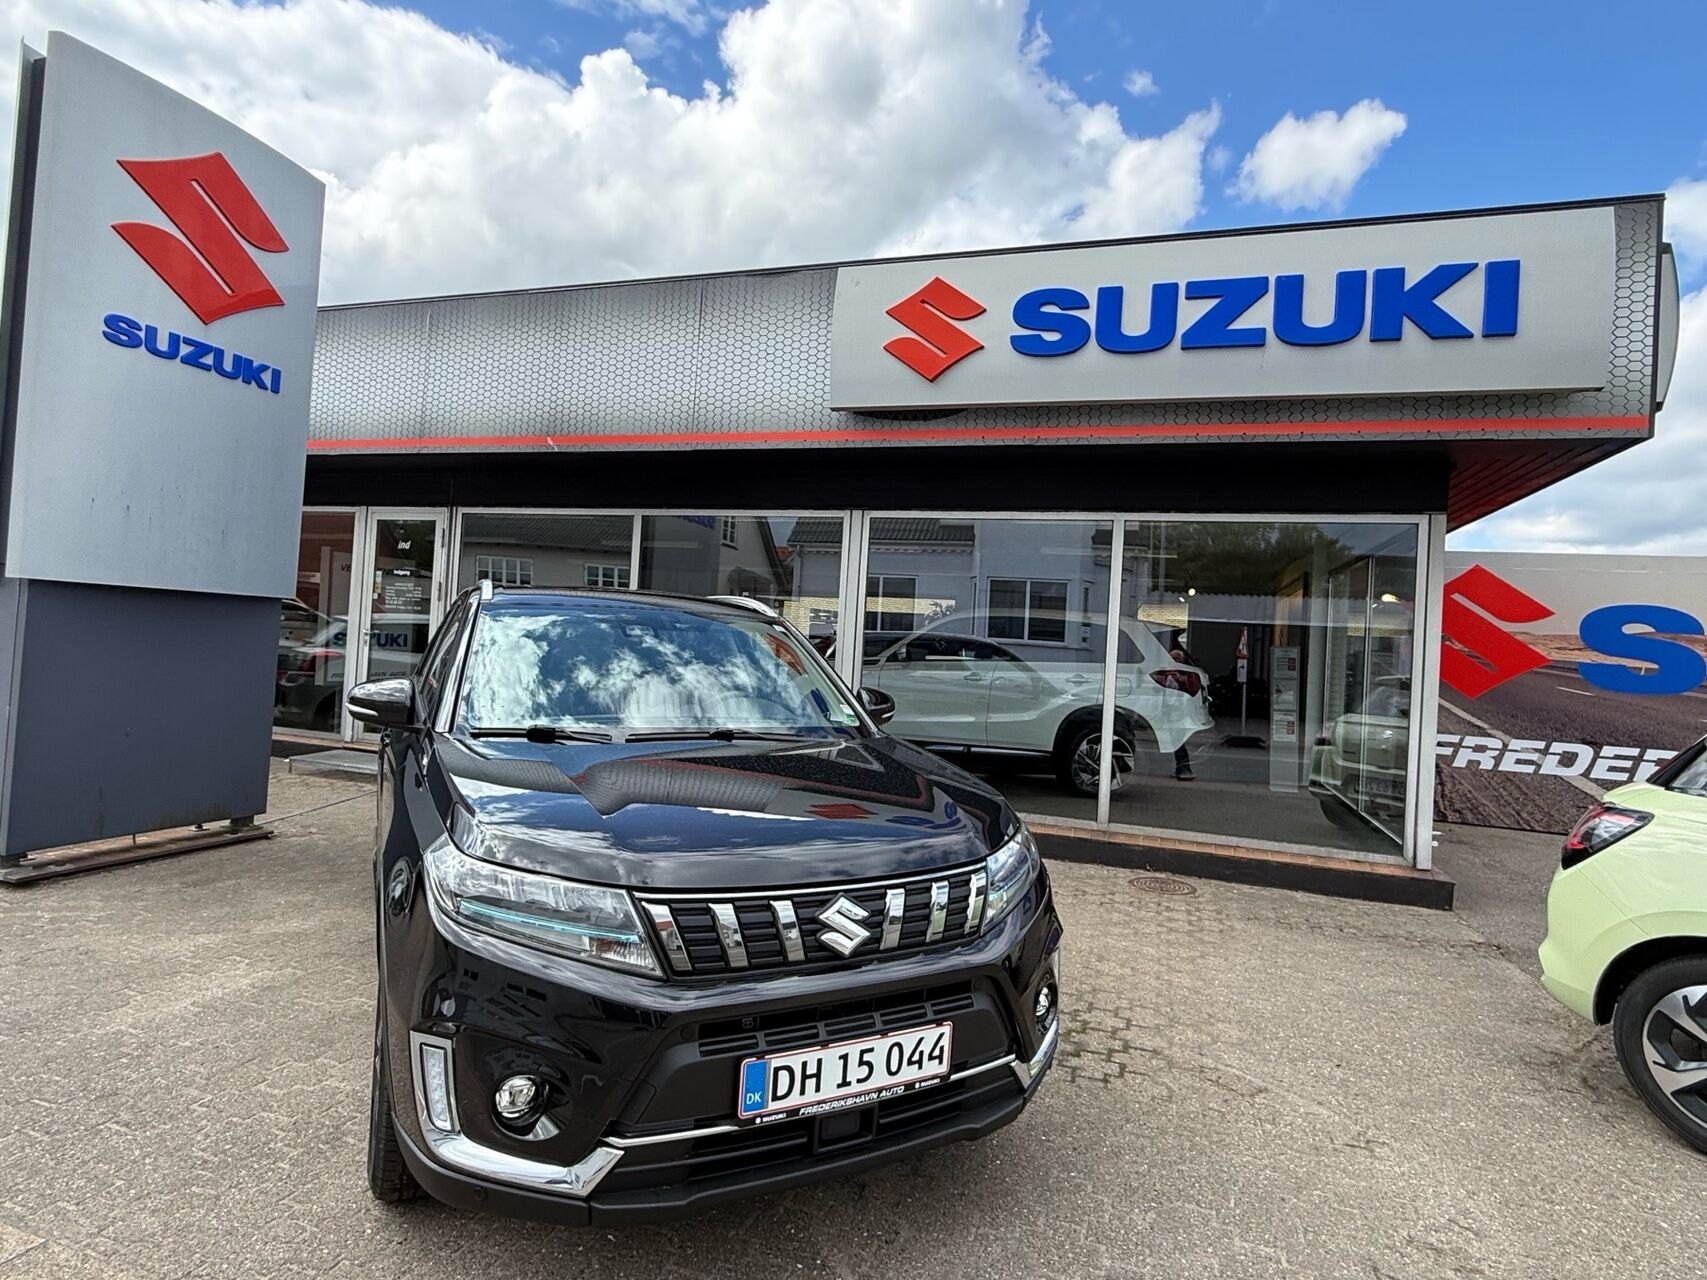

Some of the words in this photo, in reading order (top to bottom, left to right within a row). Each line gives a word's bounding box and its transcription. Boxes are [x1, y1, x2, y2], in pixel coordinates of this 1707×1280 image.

[1010, 258, 1521, 357] SUZUKI
[102, 312, 282, 395] SUZUKI
[333, 631, 408, 648] SUKI
[771, 1057, 823, 1103] DH
[836, 1046, 875, 1090] 15
[885, 1031, 946, 1077] 044
[746, 1091, 762, 1105] DK
[799, 1092, 879, 1116] FREDERIKSHAVN
[879, 1085, 905, 1098] AUTO
